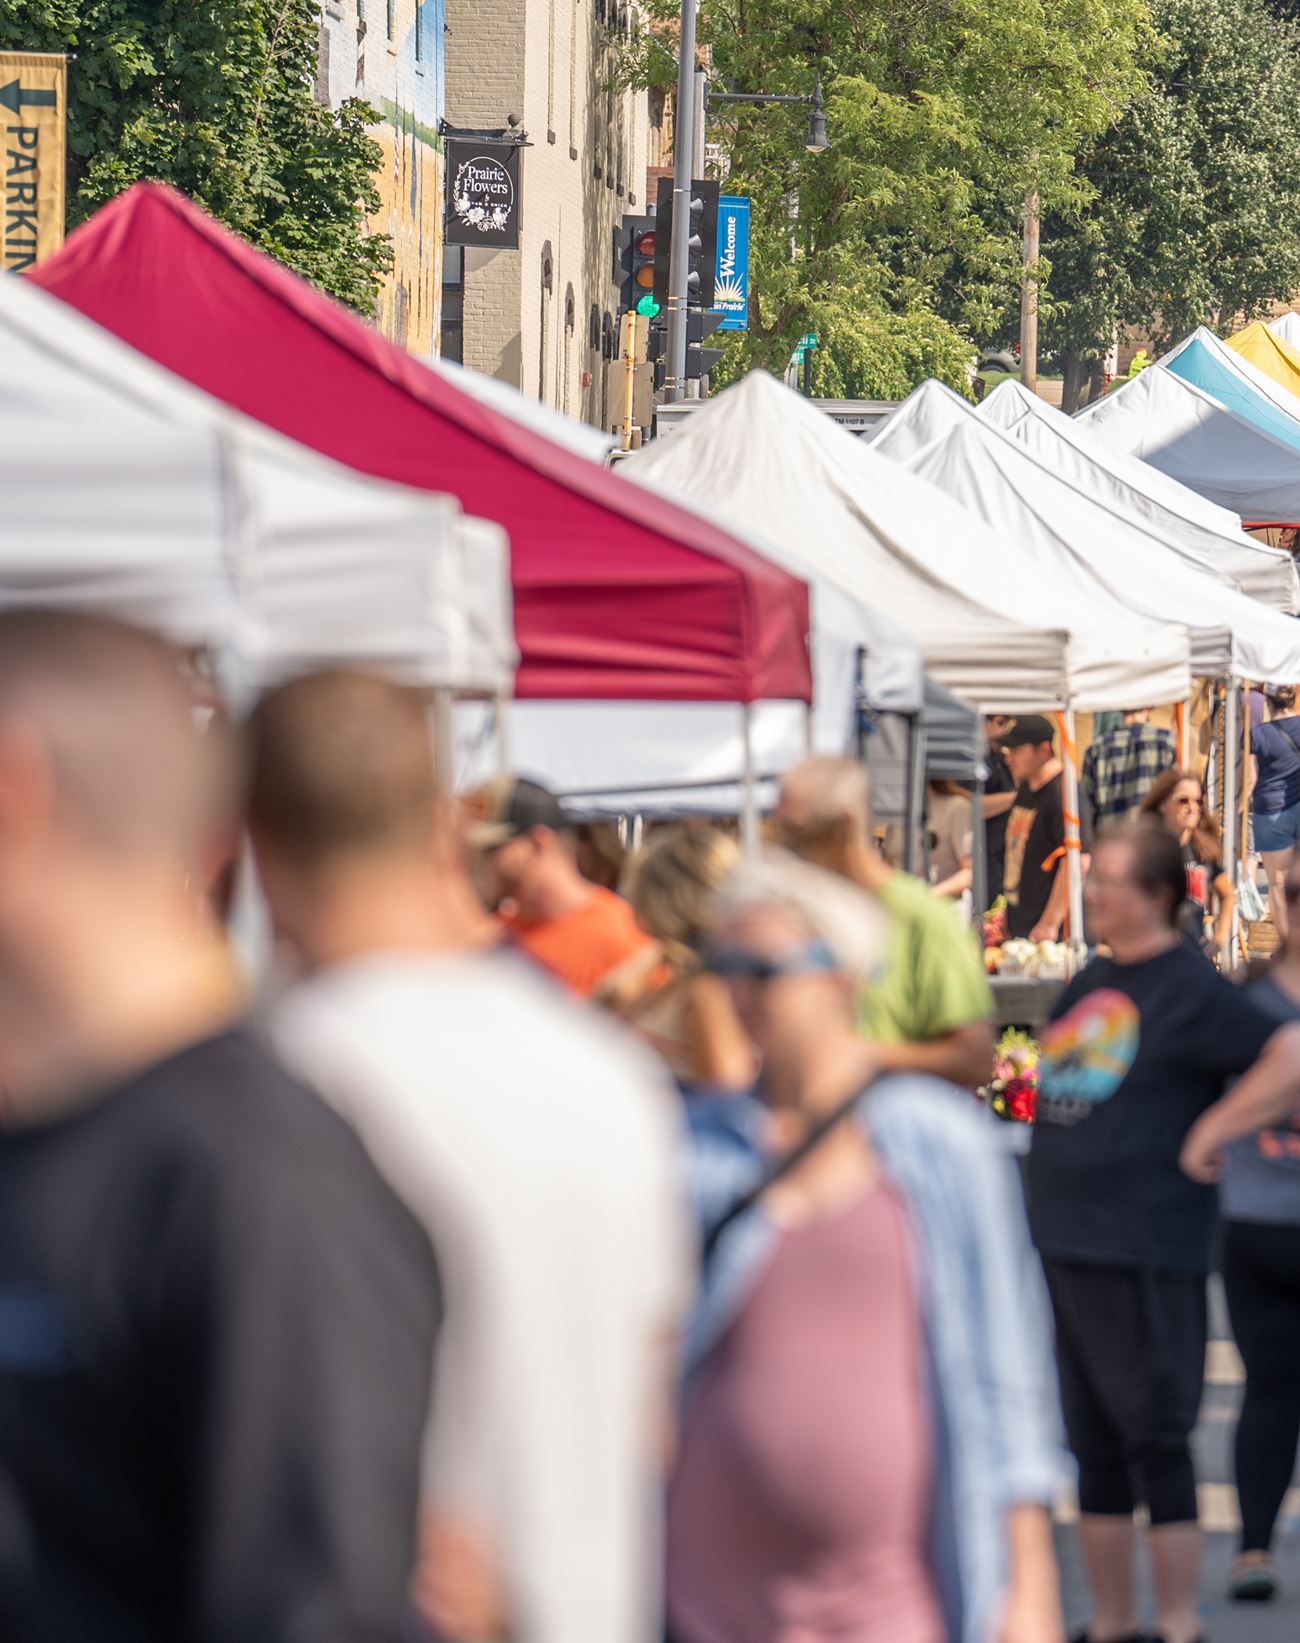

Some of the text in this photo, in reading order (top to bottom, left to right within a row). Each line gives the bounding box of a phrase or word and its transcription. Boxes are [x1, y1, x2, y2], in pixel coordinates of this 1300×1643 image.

[467, 166, 504, 180] Prairie
[463, 178, 508, 194] Flowers
[719, 216, 736, 278] Welcome
